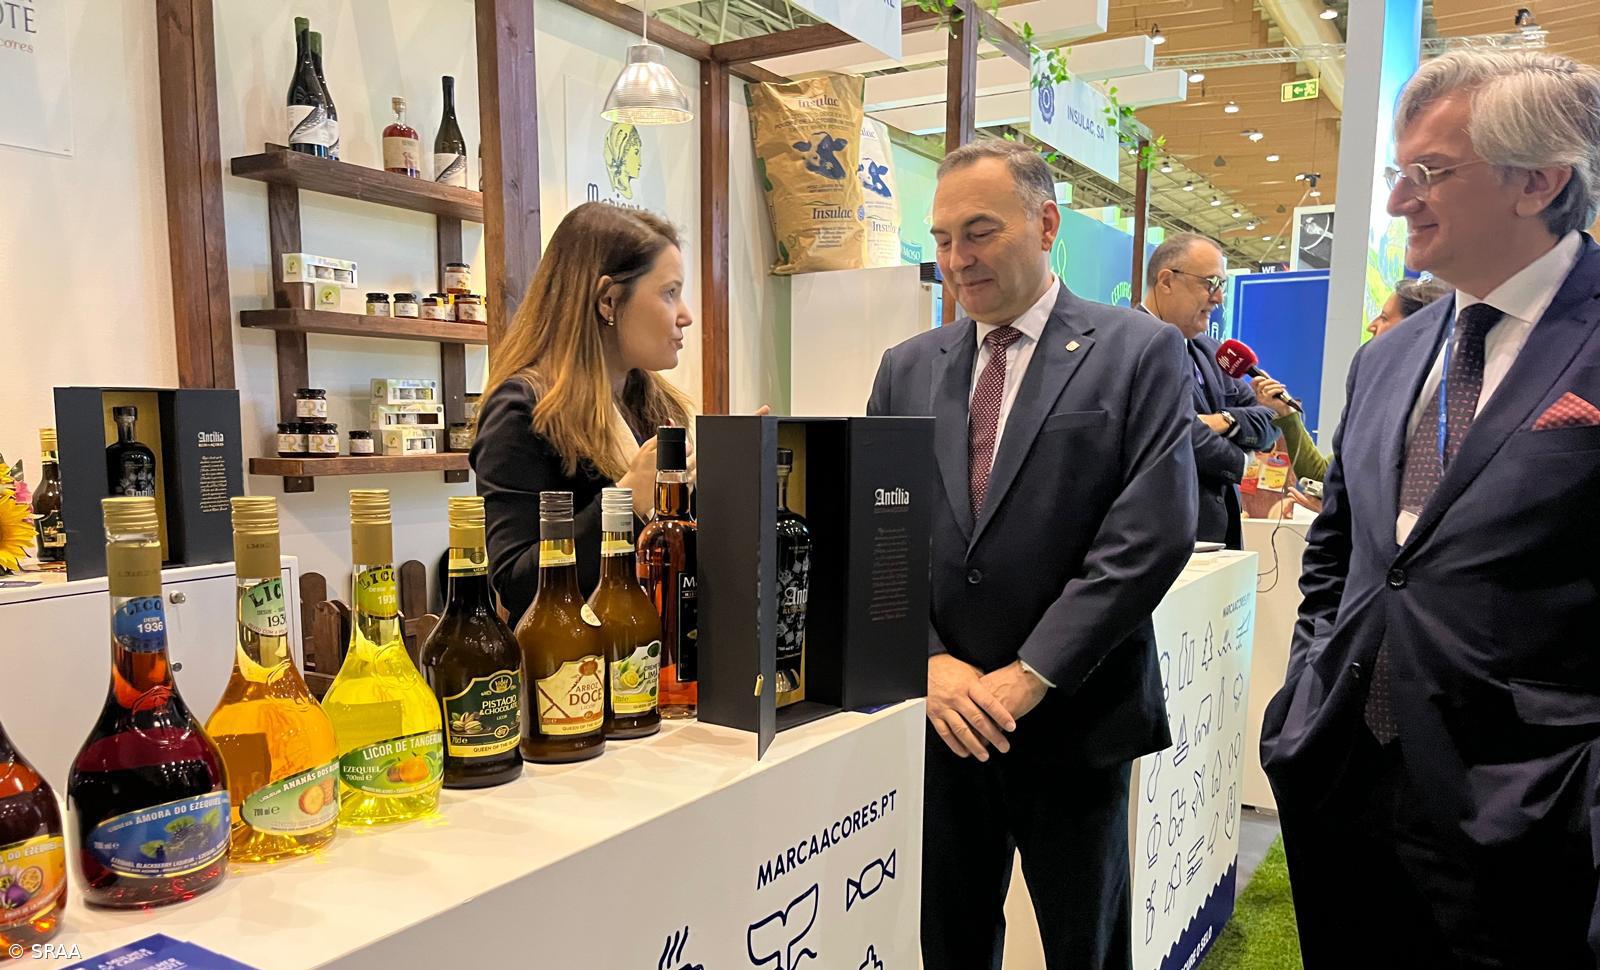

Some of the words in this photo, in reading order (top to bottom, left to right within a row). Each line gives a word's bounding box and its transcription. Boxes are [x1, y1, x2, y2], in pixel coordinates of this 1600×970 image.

[0, 2, 37, 33] TE
[1096, 124, 1105, 141] SA
[812, 206, 853, 220] Insulac
[874, 487, 910, 506] Antília
[137, 621, 164, 634] 1936
[575, 681, 599, 693] ARROZ
[482, 694, 517, 709] PISTACIO
[569, 687, 603, 706] DOCE
[362, 744, 393, 761] LICOR
[395, 740, 408, 753] DE
[473, 745, 491, 753] QUEEN
[343, 764, 381, 775] EZEQUIEL
[283, 771, 316, 791] ANANÁS
[316, 768, 329, 778] DOS
[135, 808, 171, 825] AMORA
[174, 804, 188, 815] DO
[756, 789, 897, 891] MARCAACORES.PT
[135, 860, 173, 869] BLACKBERRY
